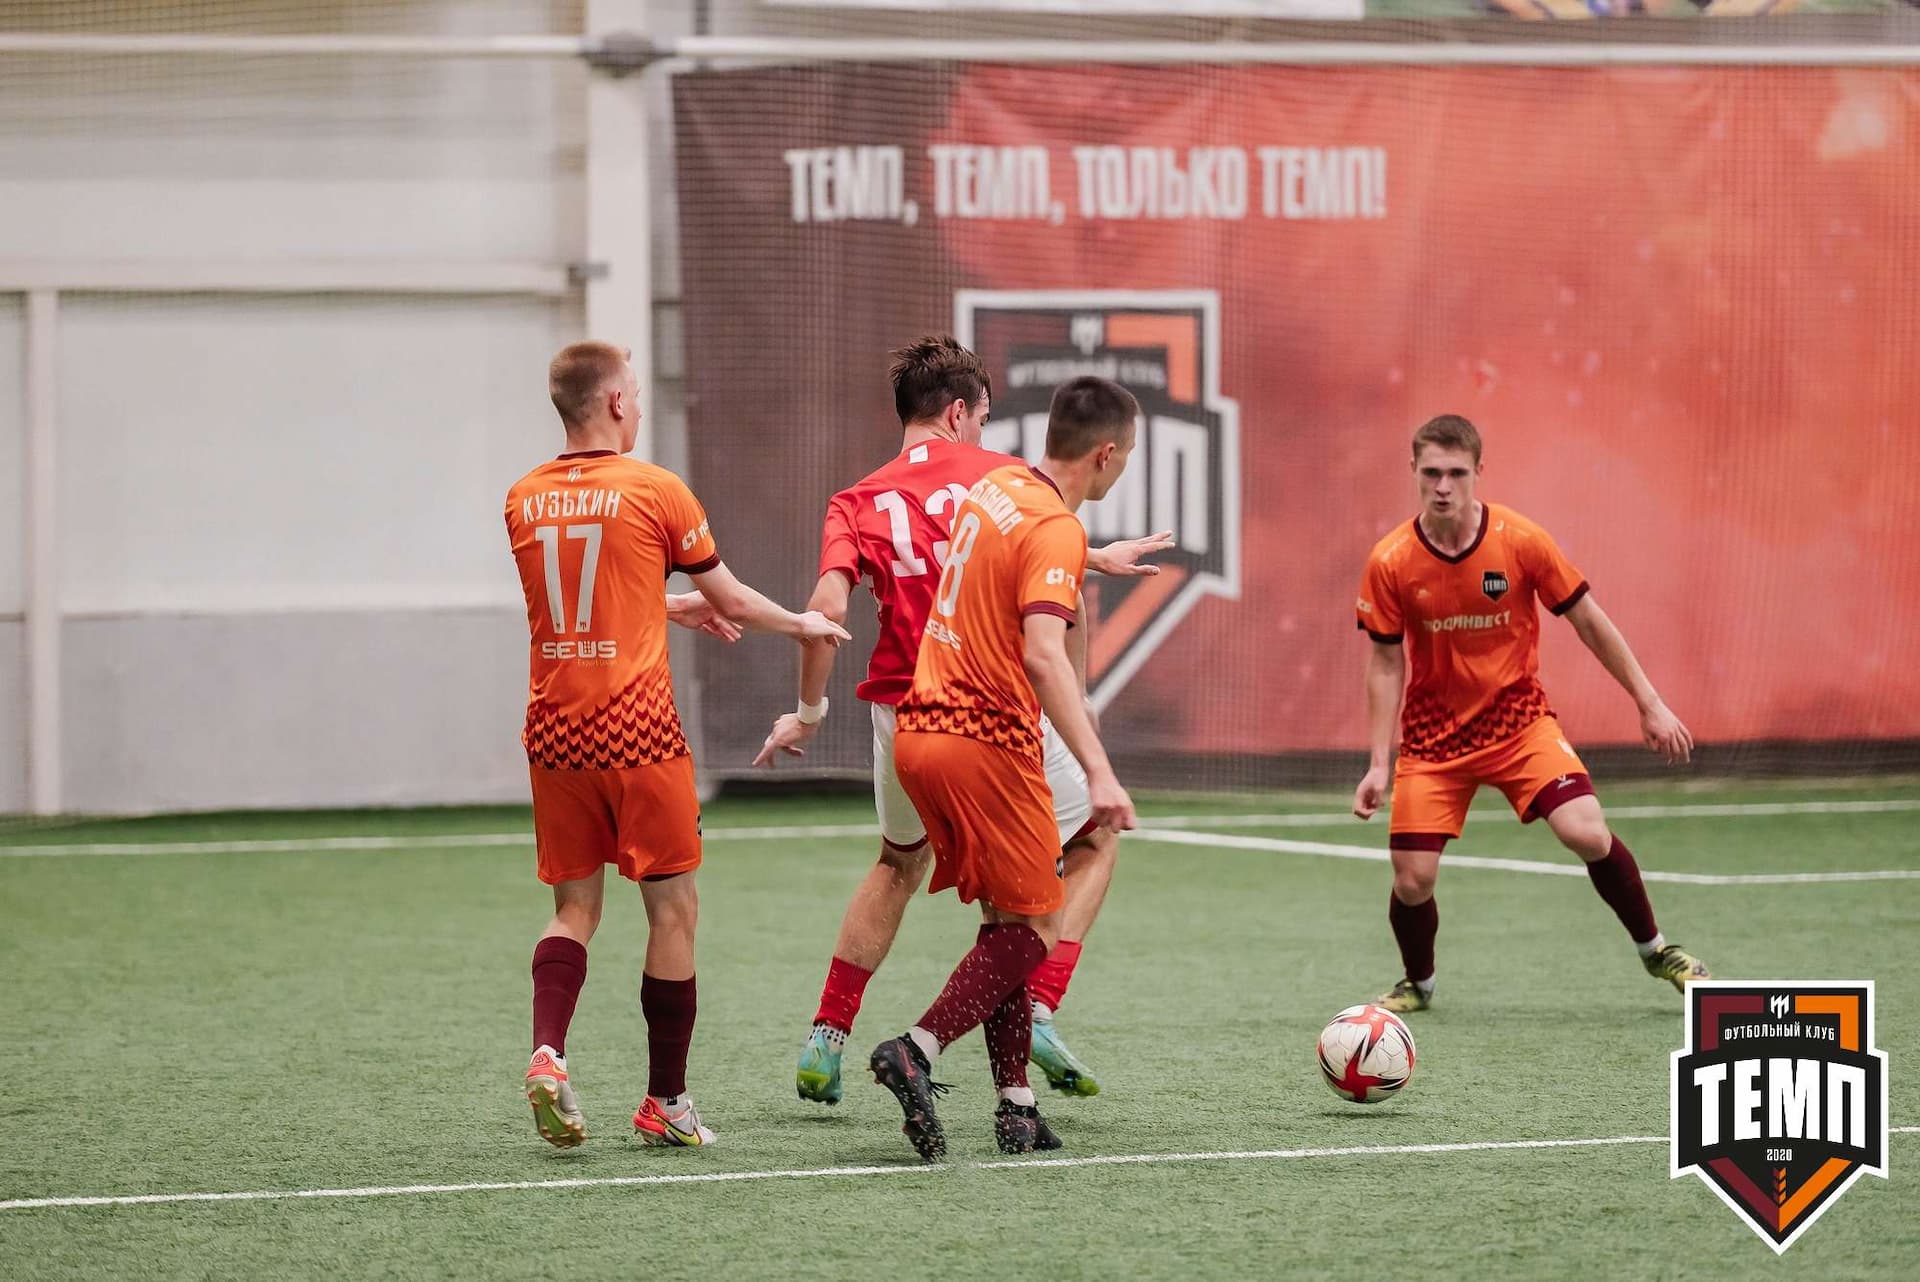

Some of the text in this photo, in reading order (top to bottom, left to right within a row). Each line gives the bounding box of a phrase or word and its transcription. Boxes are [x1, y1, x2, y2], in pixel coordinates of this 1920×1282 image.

[785, 146, 1387, 226] ТЕМП, ТЕМП, ТОЛЬКО ТЕМП!
[522, 490, 622, 524] КУЗЬКИН
[535, 523, 603, 634] 17
[936, 511, 981, 618] 8
